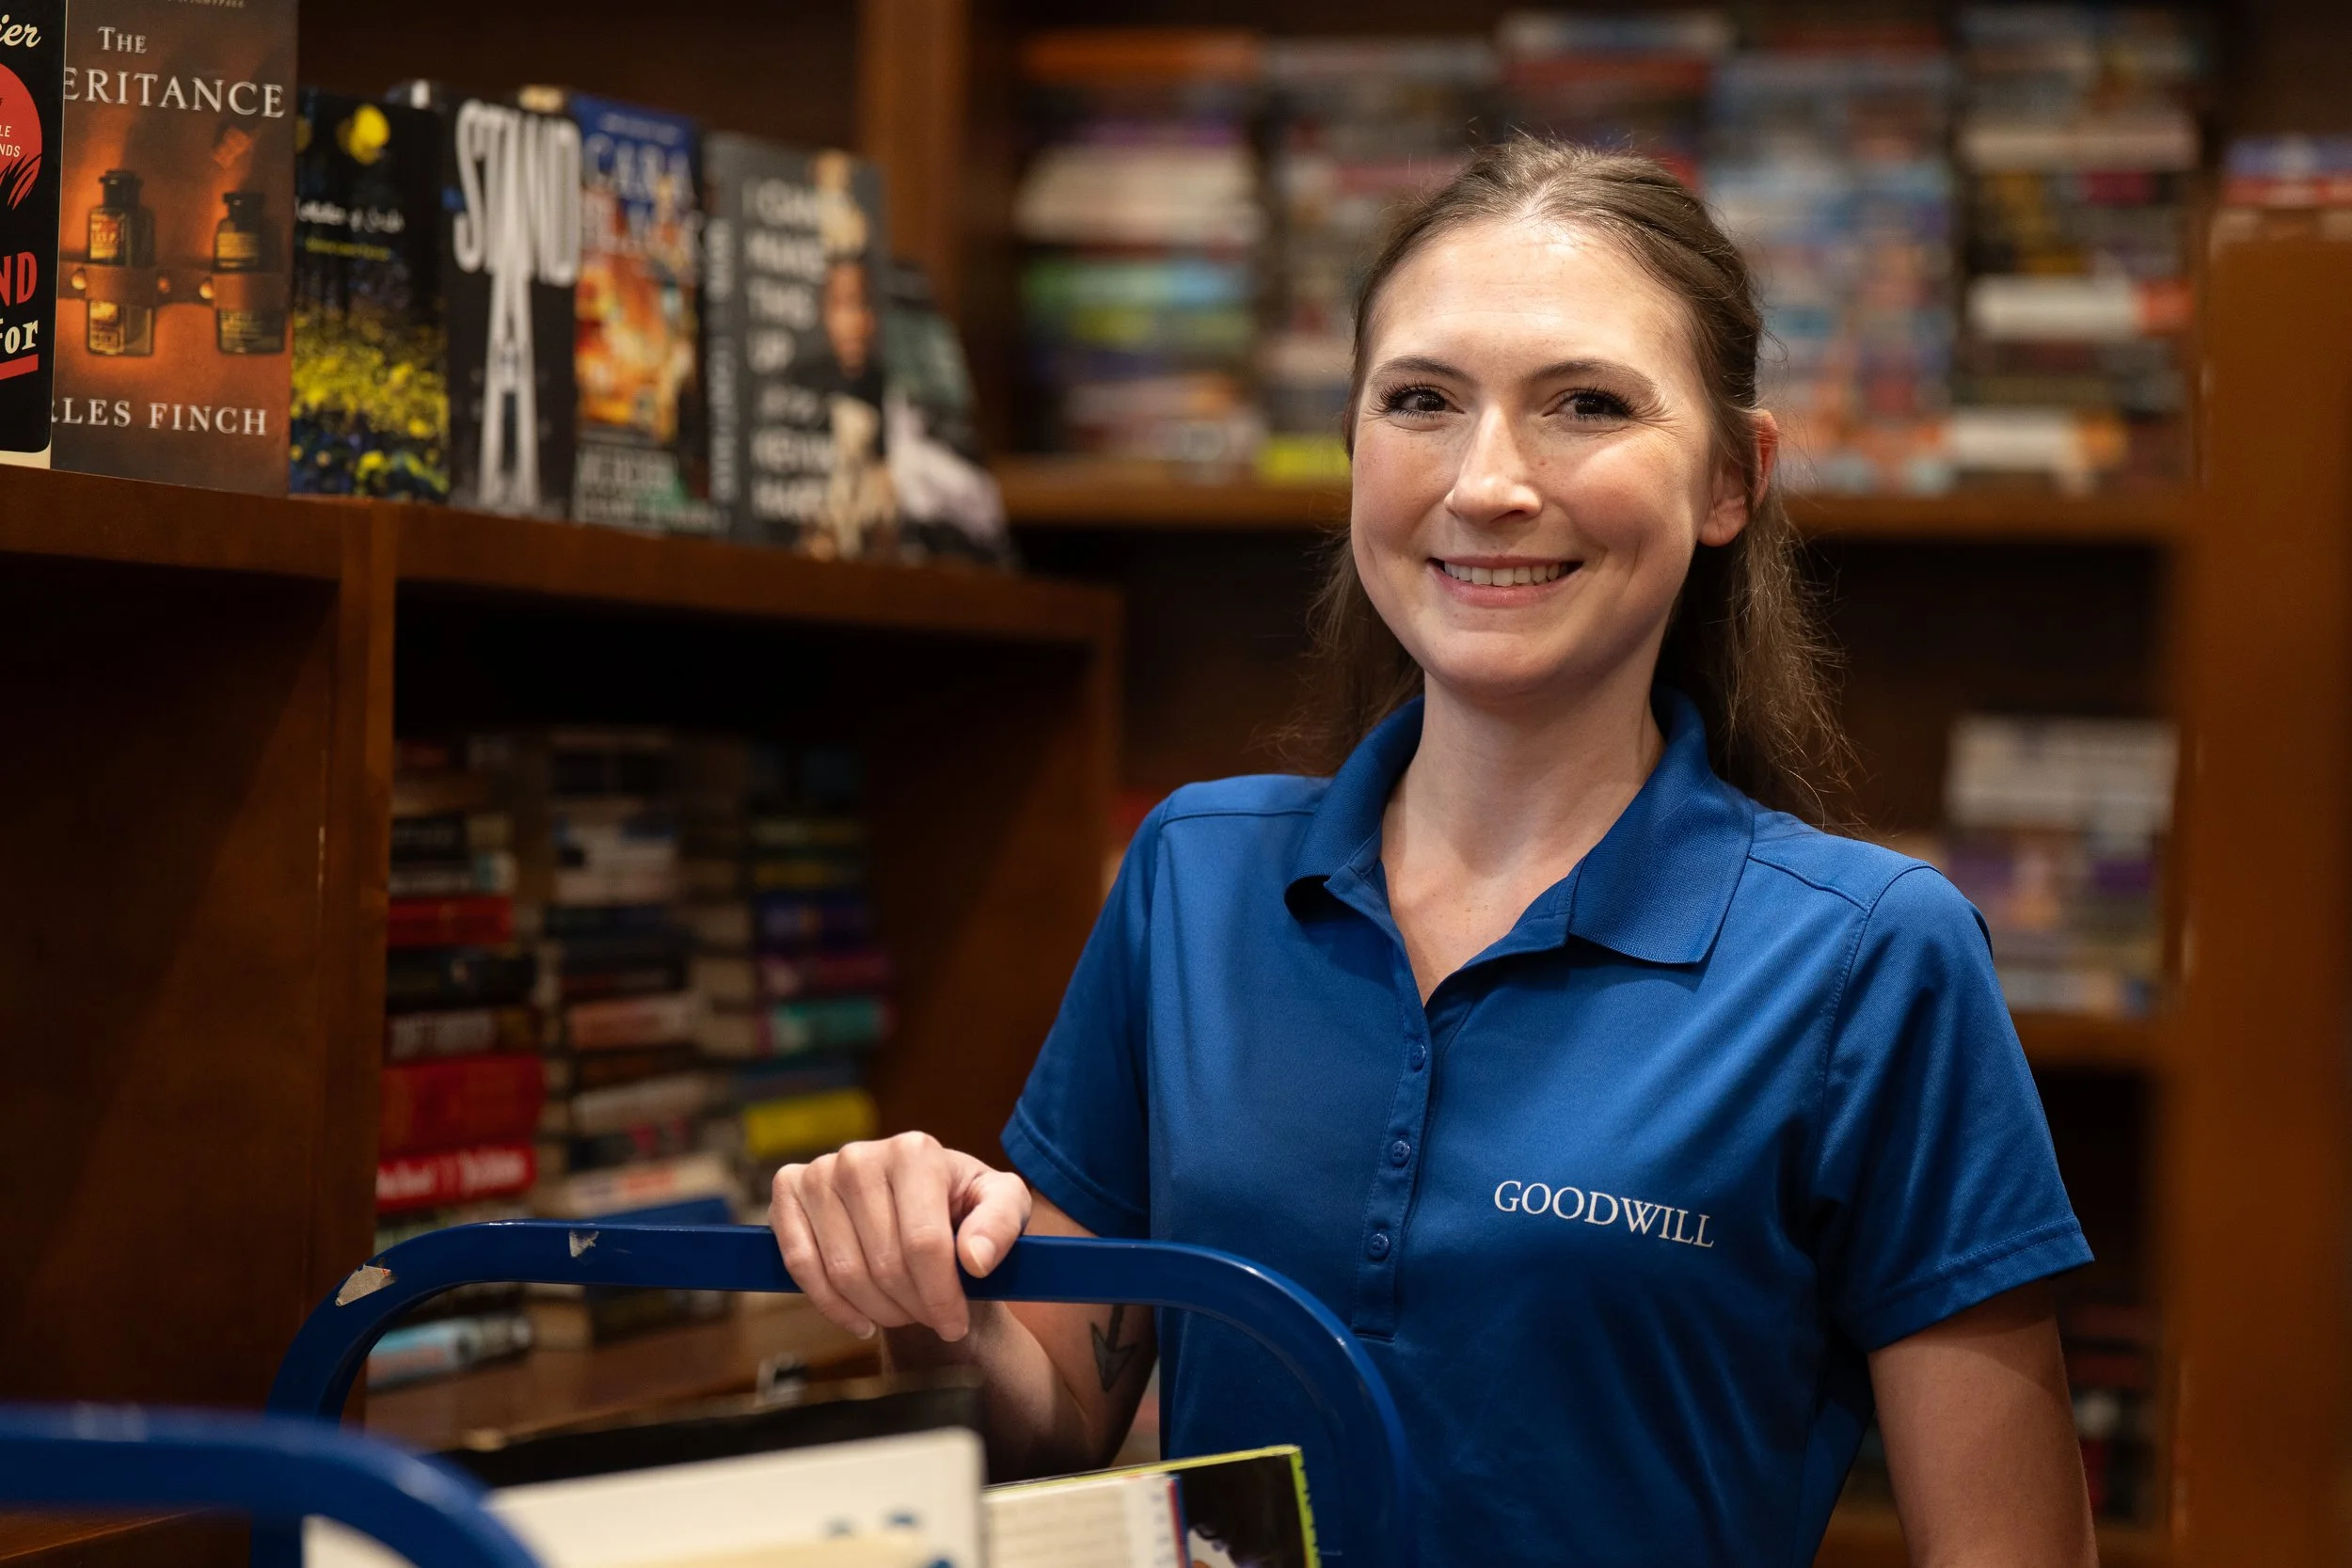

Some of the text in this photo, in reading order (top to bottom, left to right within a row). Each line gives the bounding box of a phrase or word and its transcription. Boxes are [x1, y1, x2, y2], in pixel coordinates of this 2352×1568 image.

[98, 26, 148, 54] THE
[149, 402, 267, 436] FINCH
[1494, 1180, 1714, 1248] GOODWILL
